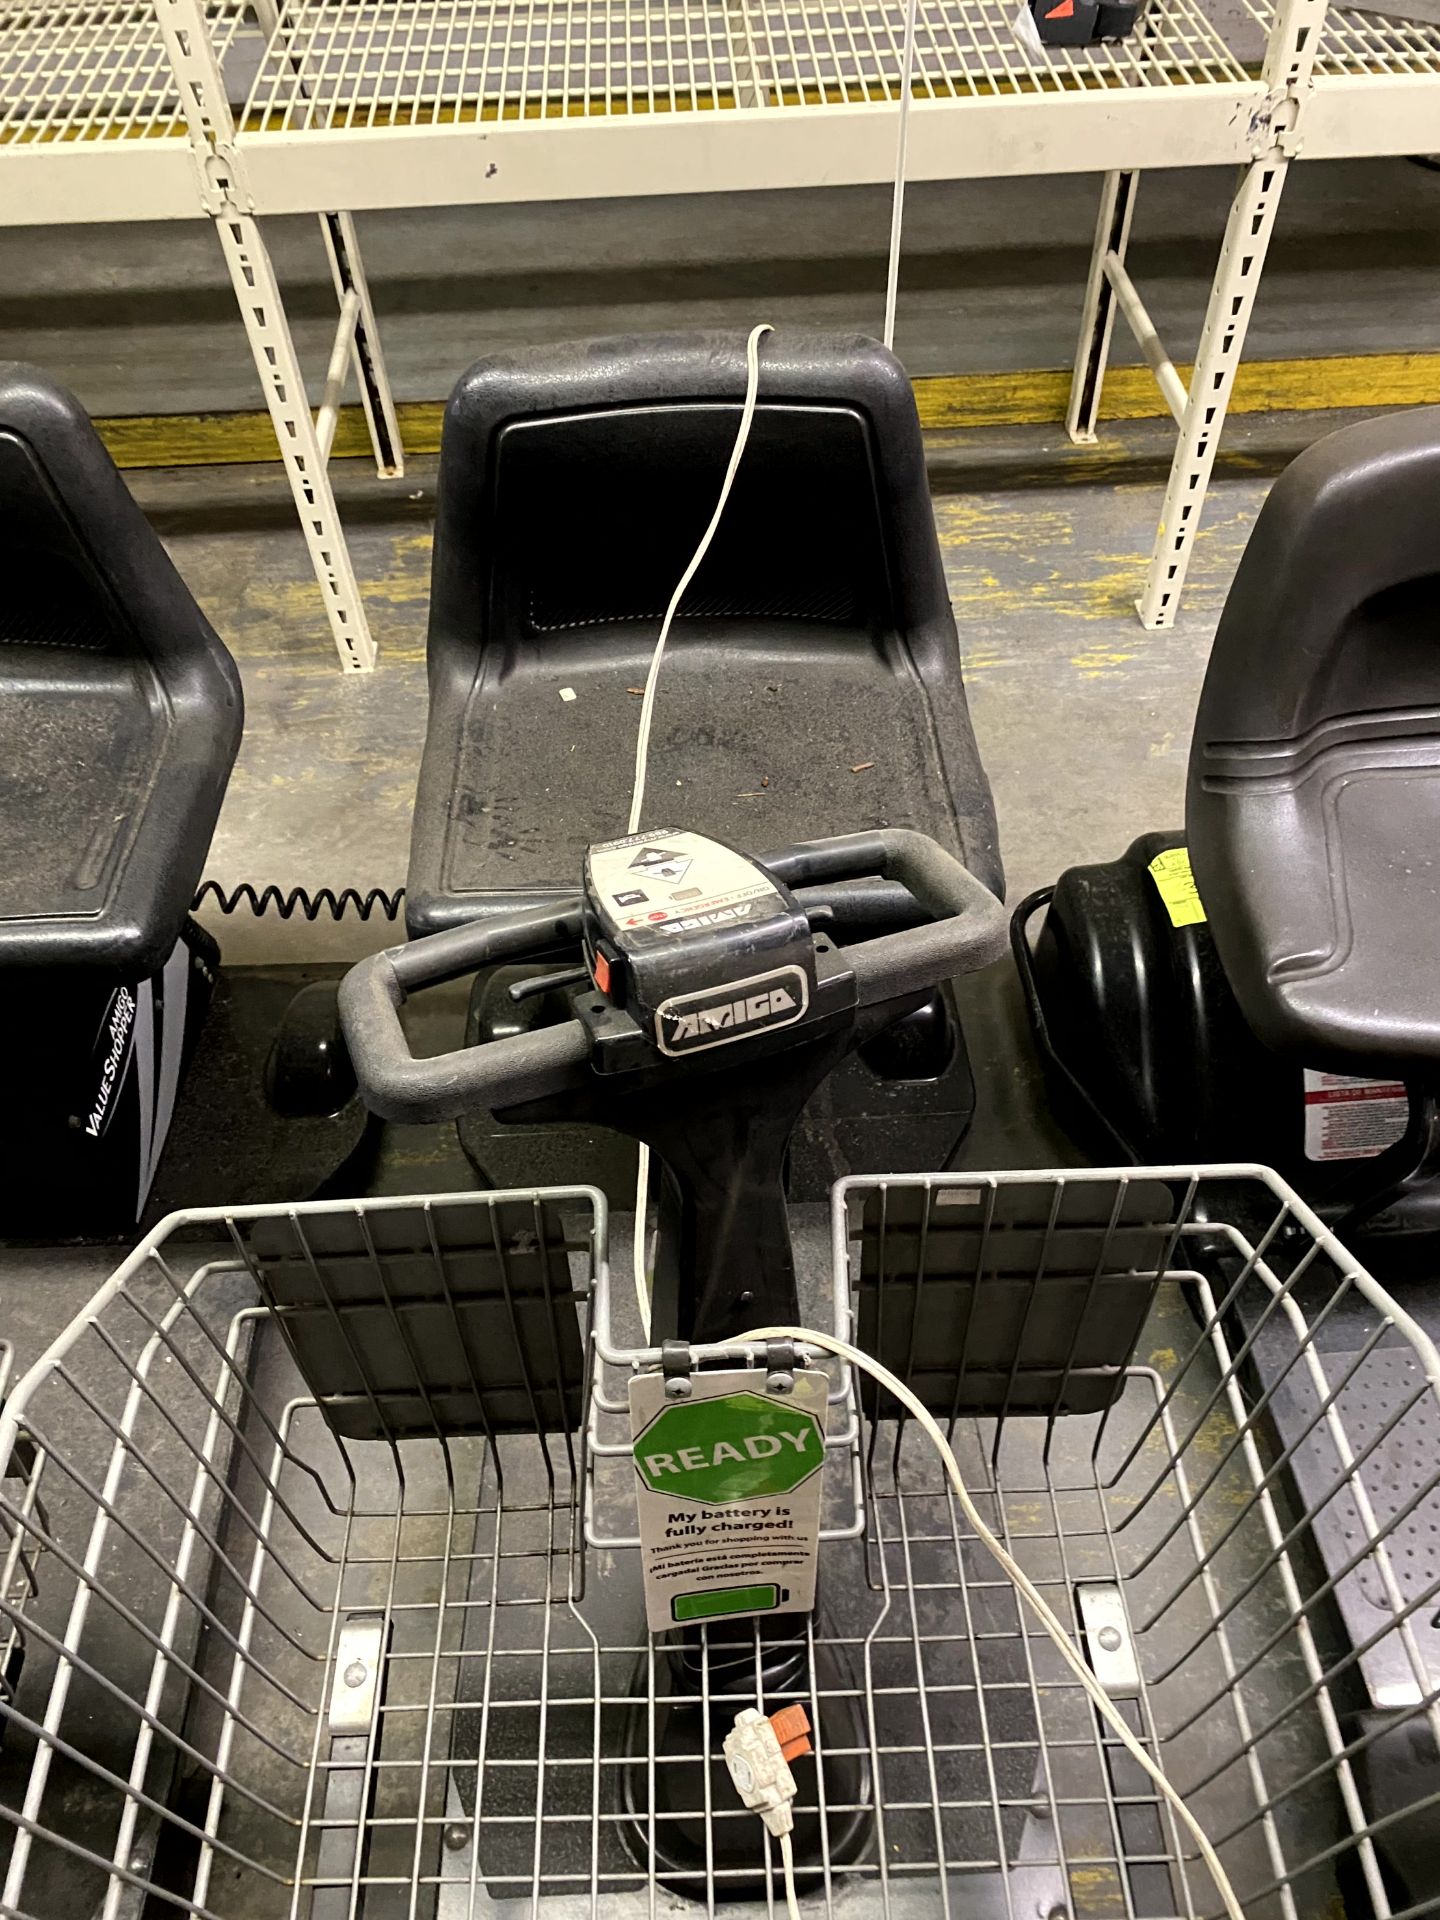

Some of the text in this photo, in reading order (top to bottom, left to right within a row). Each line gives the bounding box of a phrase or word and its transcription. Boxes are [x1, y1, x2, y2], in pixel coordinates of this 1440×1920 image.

[109, 986, 129, 1041] AMIGO
[644, 1428, 810, 1477] READY
[668, 1506, 791, 1524] My battery is
[665, 1520, 793, 1538] fully charged!
[650, 1543, 682, 1554] Thank
[684, 1541, 703, 1549] you
[722, 1535, 770, 1543] shopping
[701, 1563, 739, 1572] Gracias
